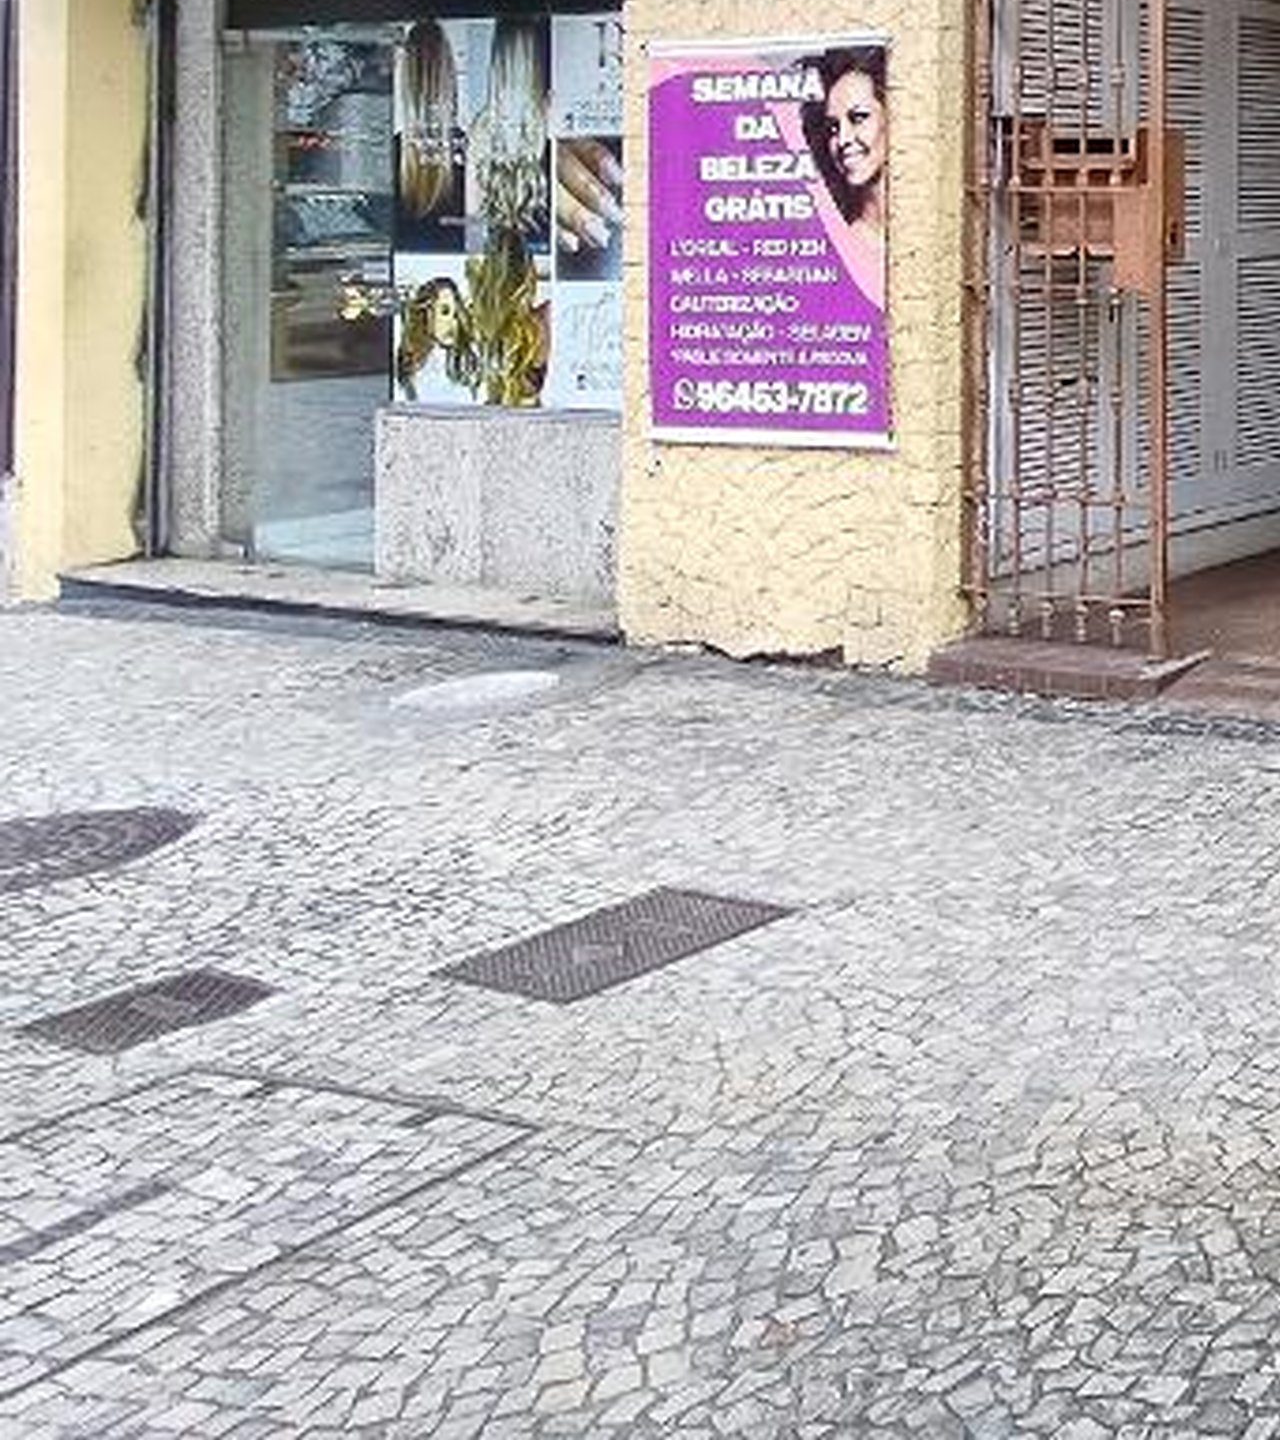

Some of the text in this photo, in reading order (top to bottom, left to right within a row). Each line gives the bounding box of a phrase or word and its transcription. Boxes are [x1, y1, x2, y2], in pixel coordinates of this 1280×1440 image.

[692, 67, 825, 103] SEMANA
[735, 115, 779, 141] DA
[700, 154, 816, 181] BELEZA
[705, 188, 814, 222] GRÁTIS
[697, 380, 869, 413] 96463-7872
